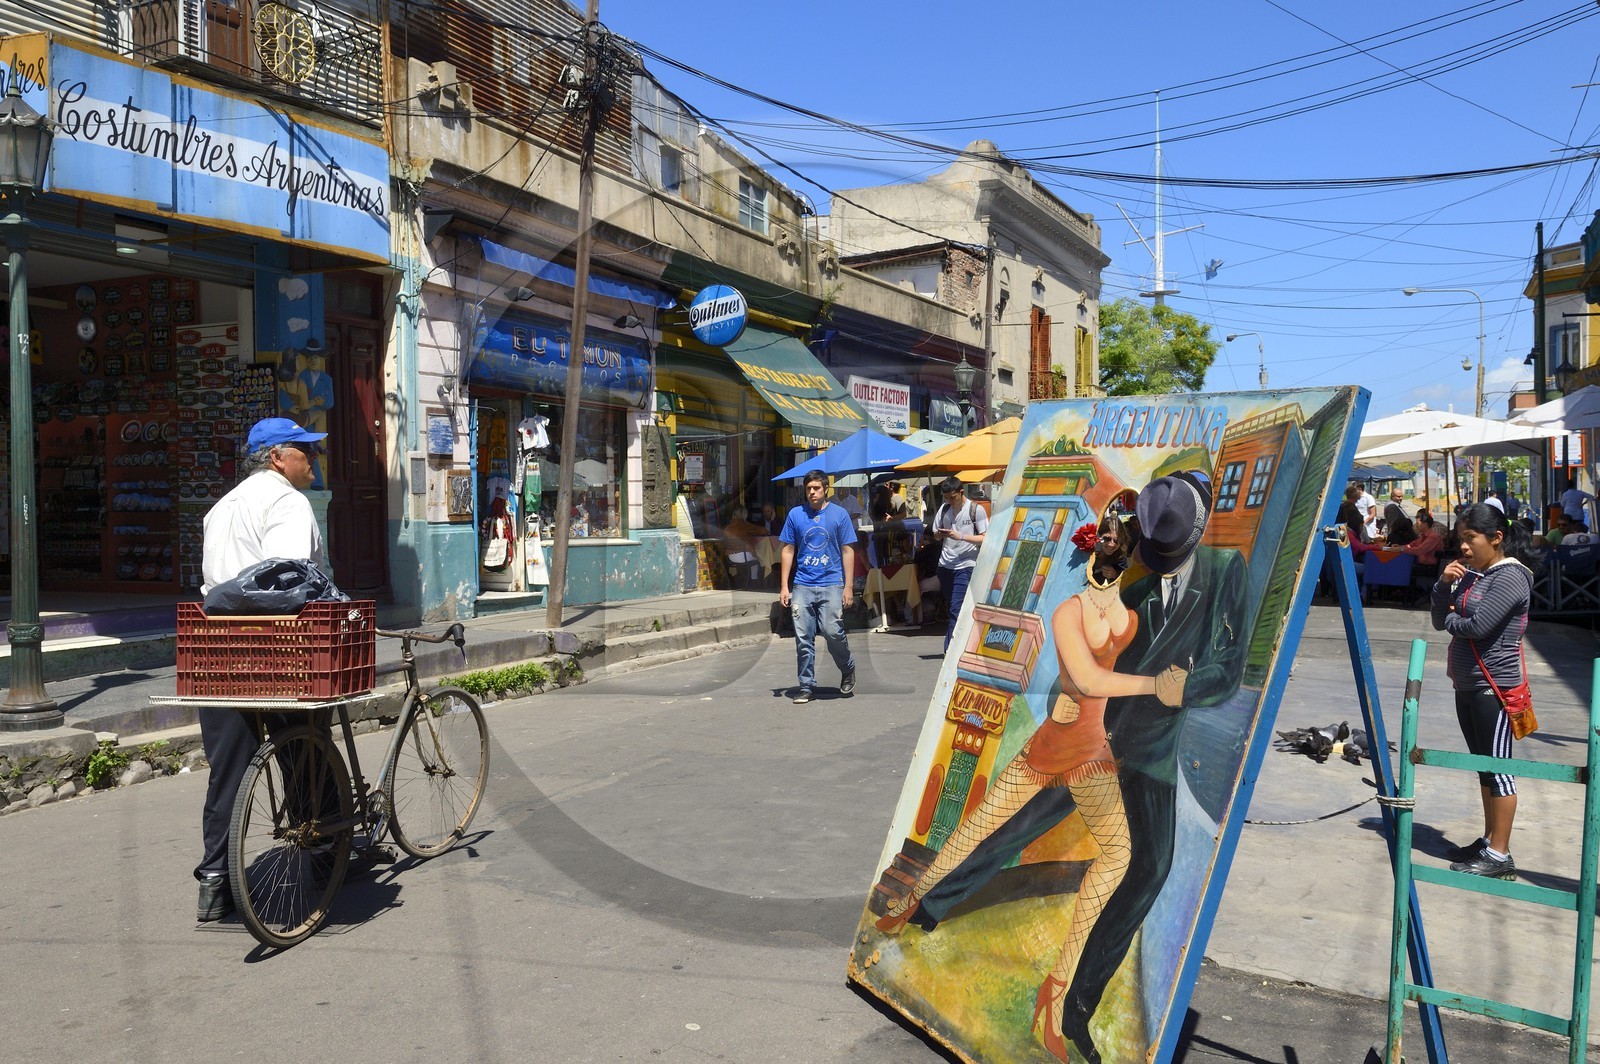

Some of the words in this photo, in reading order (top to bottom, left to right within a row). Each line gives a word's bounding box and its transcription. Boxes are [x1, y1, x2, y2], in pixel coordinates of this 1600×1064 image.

[57, 78, 238, 178] Costumbres
[242, 140, 385, 217] Argentinas
[690, 298, 740, 329] Quilmes
[205, 346, 221, 354] BAR
[512, 326, 547, 356] EL
[554, 334, 622, 370] TMON
[511, 353, 622, 384] REGLOS
[735, 359, 833, 391] RESTAURANT
[760, 384, 800, 411] LA
[854, 382, 879, 402] OUTLET
[880, 386, 909, 406] FACTORY
[1082, 401, 1231, 456] ARGENTINA
[954, 685, 1003, 721] CAMINITO
